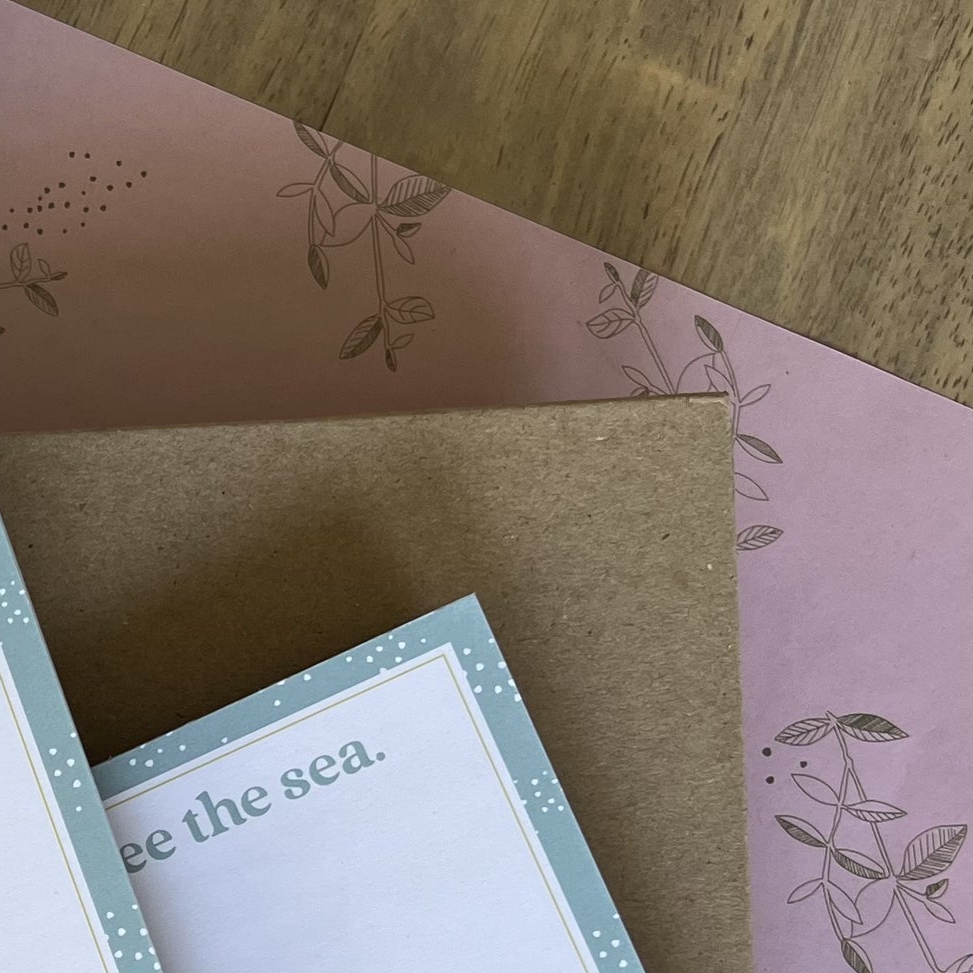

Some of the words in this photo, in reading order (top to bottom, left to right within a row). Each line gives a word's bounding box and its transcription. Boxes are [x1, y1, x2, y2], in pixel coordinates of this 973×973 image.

[119, 828, 176, 874] ee
[182, 790, 272, 843] the
[280, 740, 386, 800] sea.
